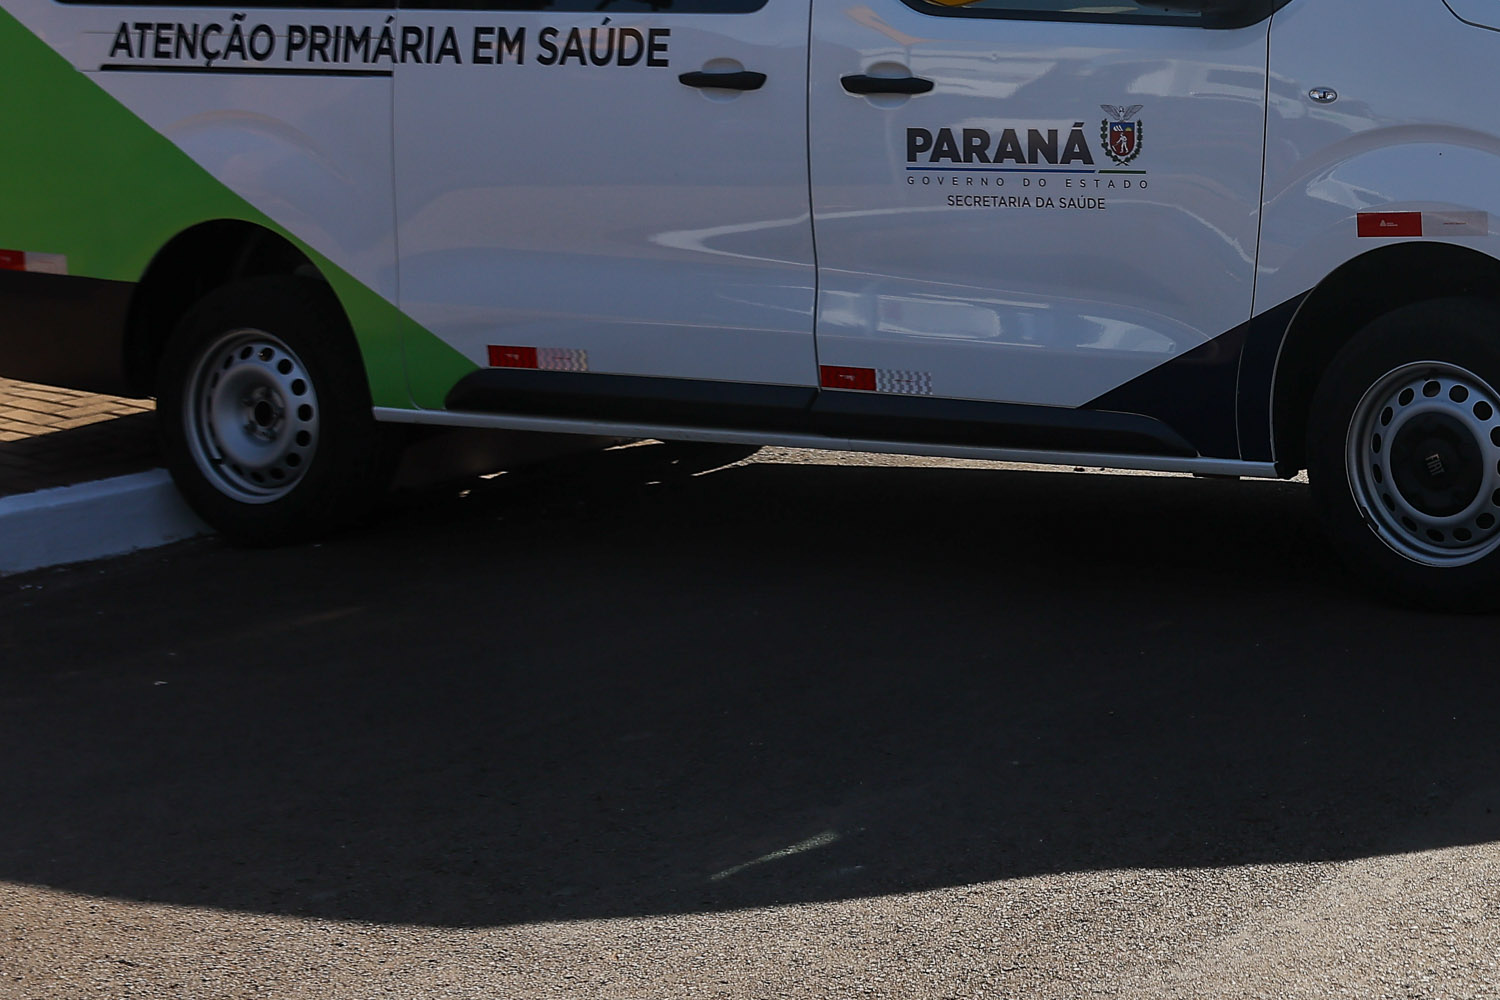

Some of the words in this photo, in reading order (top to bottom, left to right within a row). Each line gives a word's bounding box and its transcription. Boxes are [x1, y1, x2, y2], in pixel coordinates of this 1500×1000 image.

[110, 13, 277, 67] ATENÇÃO
[285, 15, 463, 66] PRIMÁRIA
[471, 26, 526, 66] EM
[536, 18, 672, 68] SAÚDE
[906, 122, 1095, 165] PARANÁ
[907, 175, 1005, 187] GOVERNO
[1022, 177, 1047, 188] DO
[1065, 178, 1148, 190] ESTADO
[947, 194, 1031, 209] SECRETARIA
[1035, 197, 1055, 209] DA
[1059, 195, 1106, 210] SAÚDE
